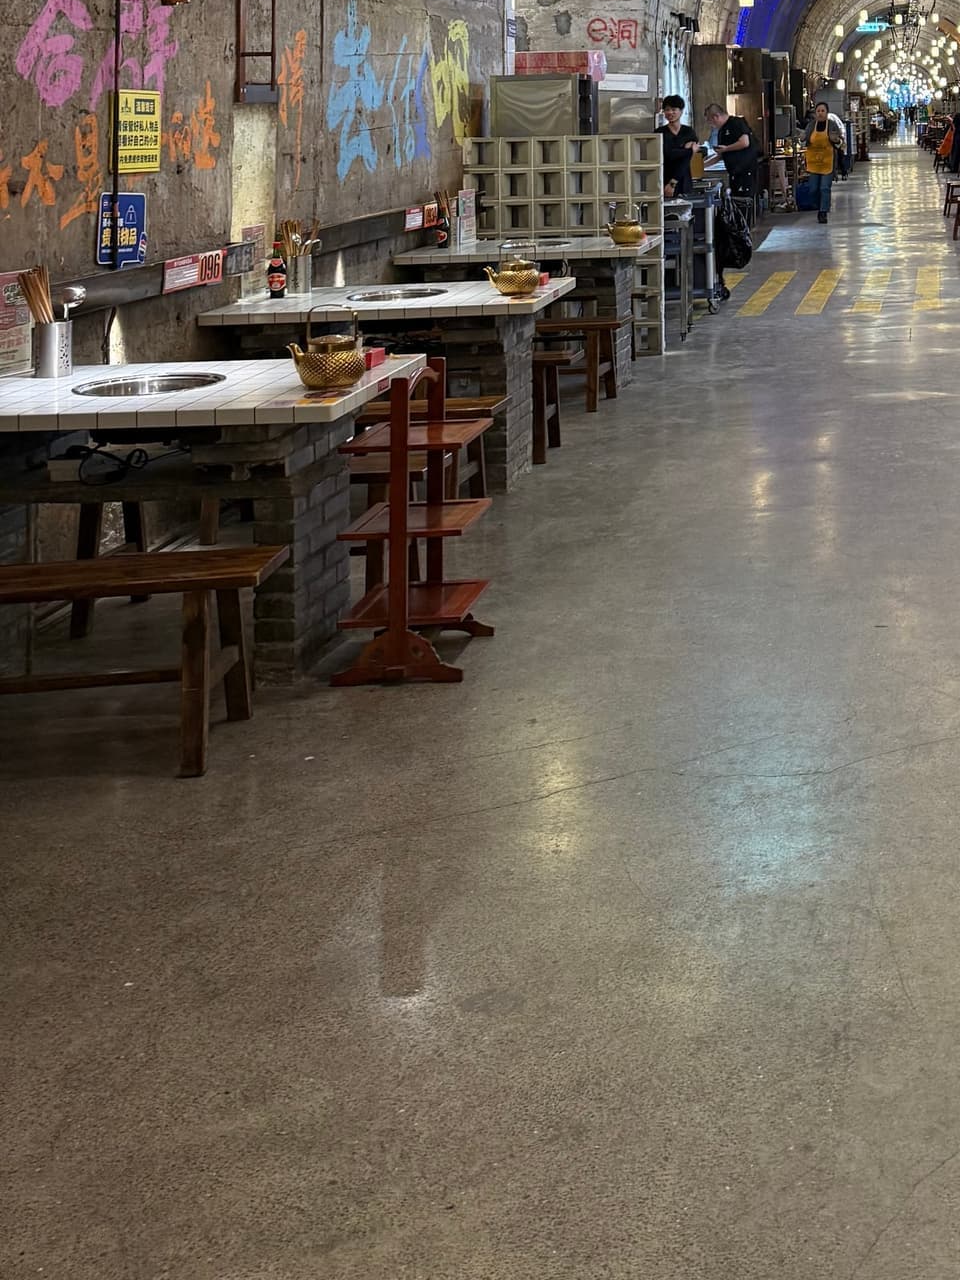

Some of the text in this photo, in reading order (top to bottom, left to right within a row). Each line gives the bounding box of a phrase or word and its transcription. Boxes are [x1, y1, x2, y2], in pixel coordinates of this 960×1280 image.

[101, 227, 137, 248] 贵物品
[200, 253, 221, 282] 096
